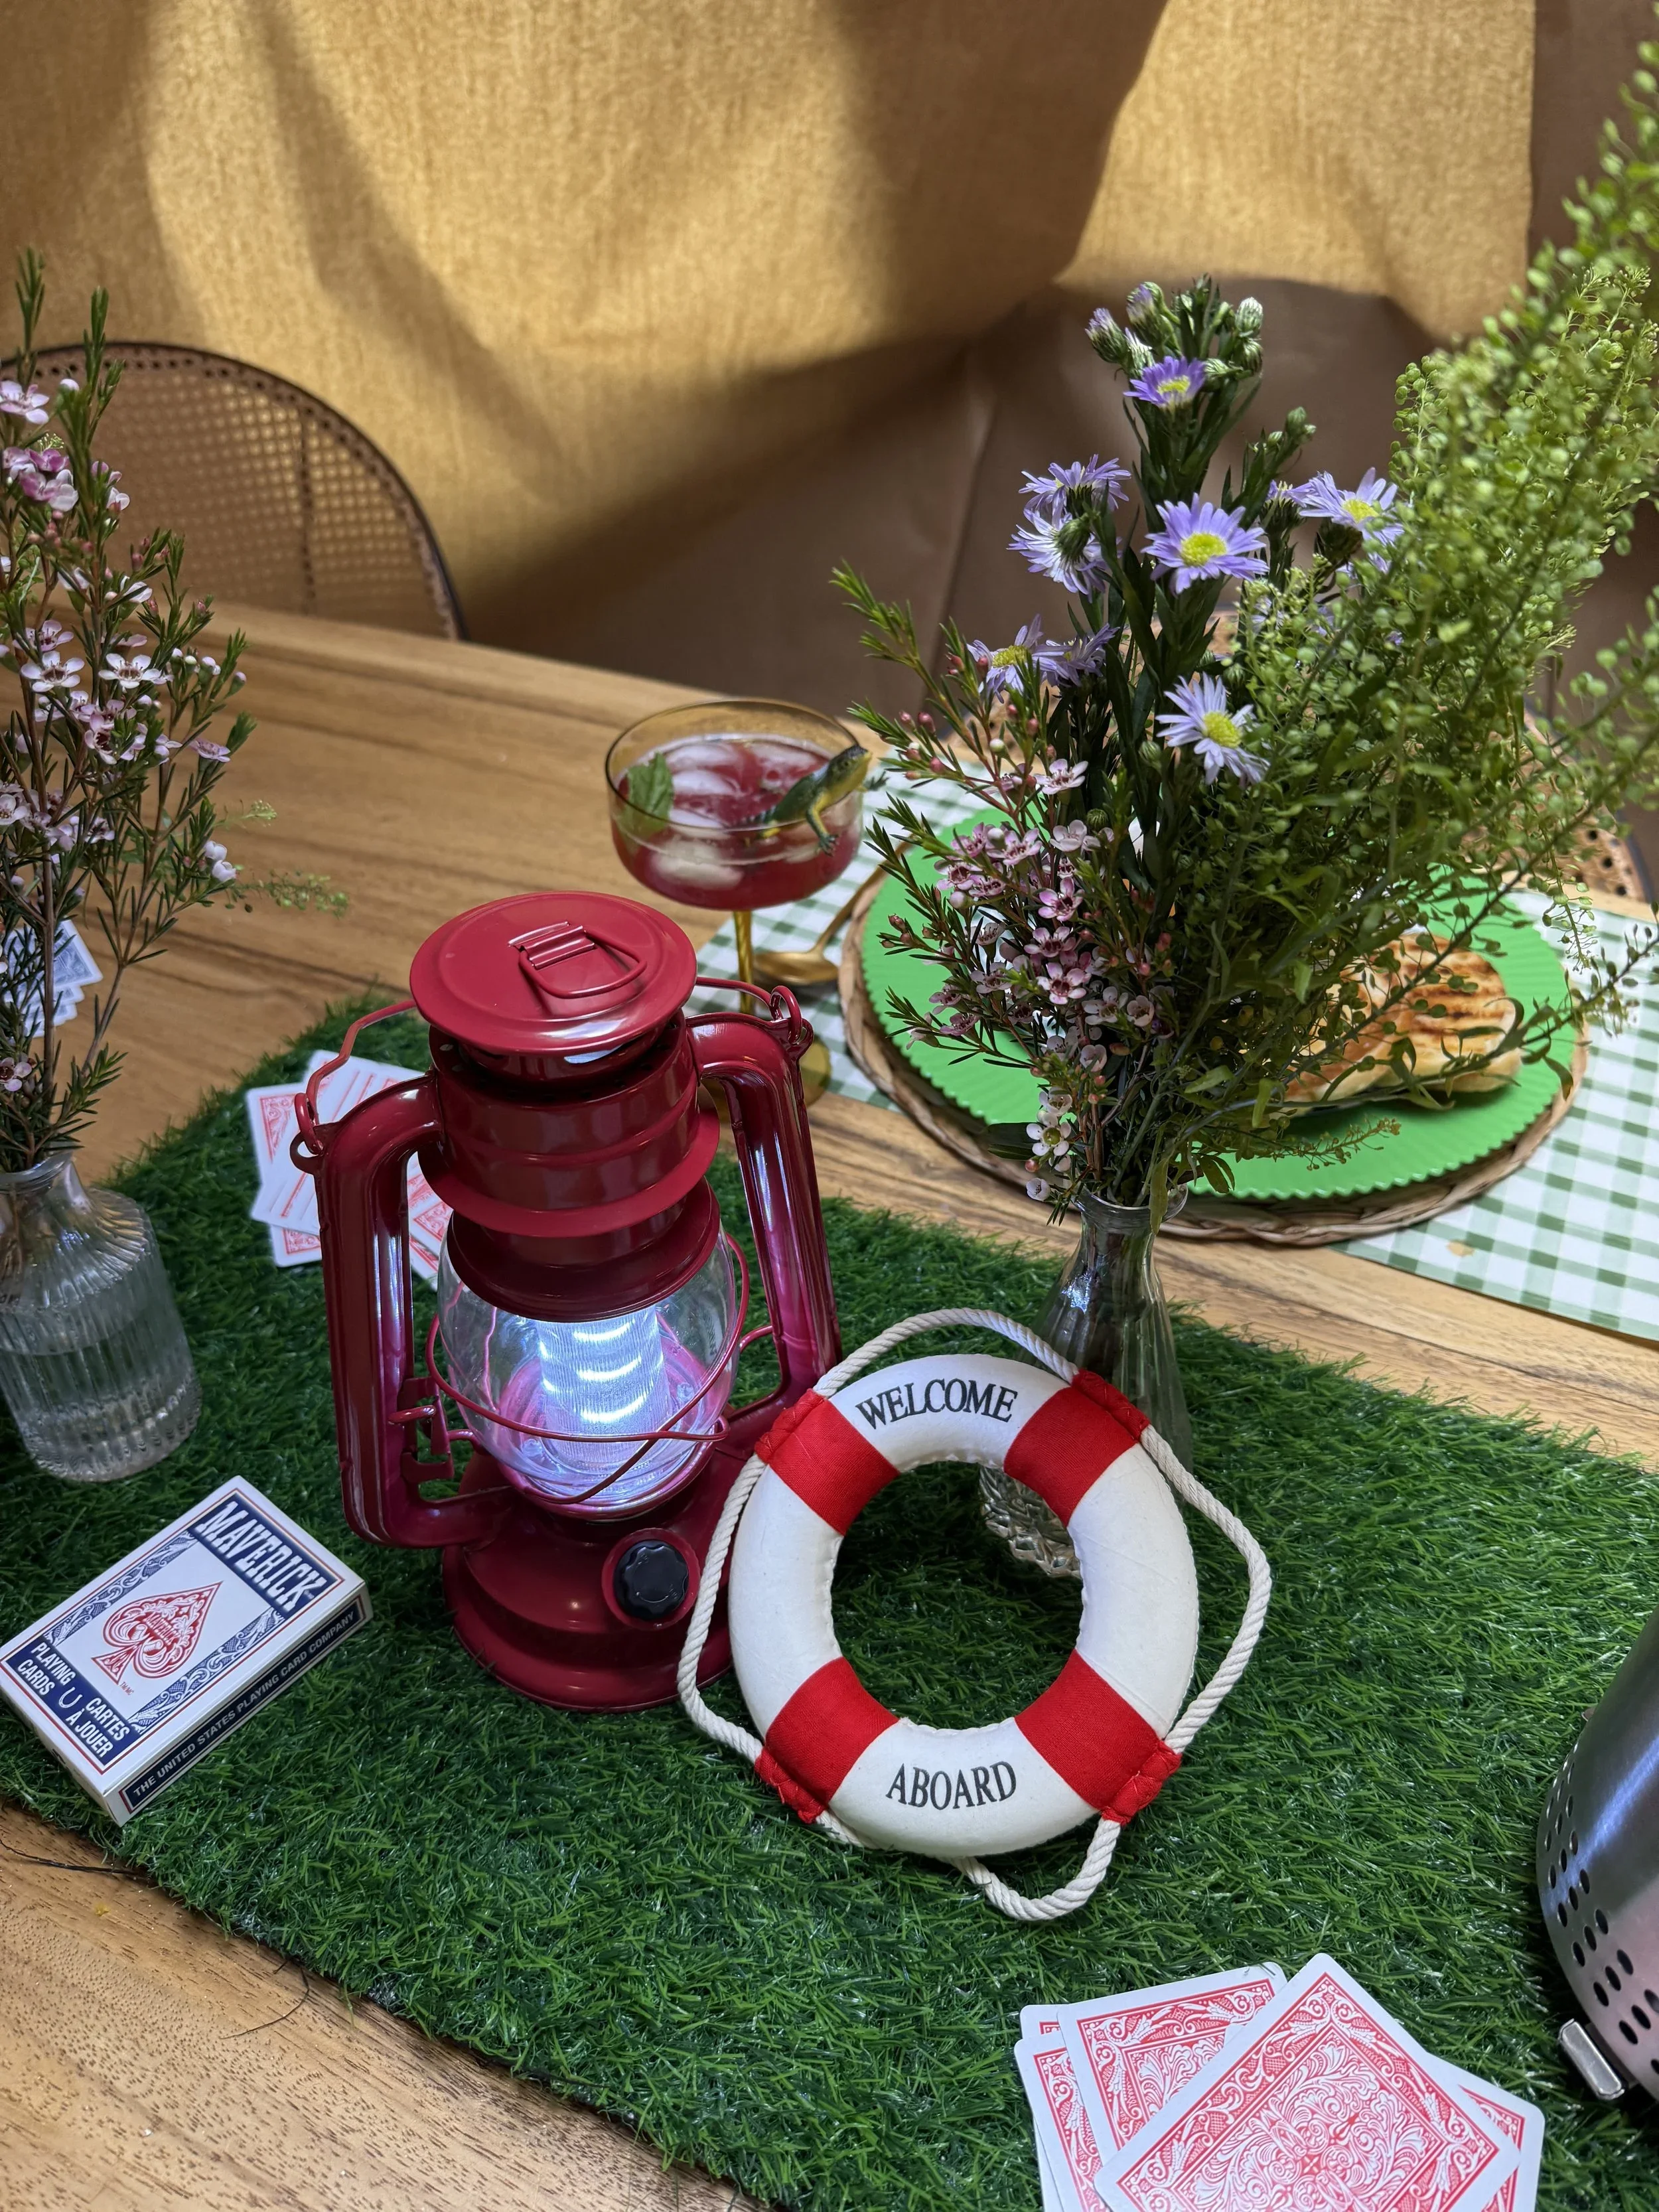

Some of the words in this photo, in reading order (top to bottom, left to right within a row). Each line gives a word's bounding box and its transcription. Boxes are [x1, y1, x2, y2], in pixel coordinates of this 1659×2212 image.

[855, 1378, 1018, 1430] WELCOME
[194, 1501, 327, 1612] MAVERICK
[143, 1611, 181, 1645] MAVERICK
[17, 1659, 55, 1696] CARDS
[31, 1642, 76, 1686] PLAYING
[85, 1698, 130, 1741] CARTES
[133, 1775, 157, 1797] THE
[157, 1743, 196, 1778] UNITED
[197, 1710, 236, 1745] STATES
[236, 1674, 279, 1712] PLAYING
[281, 1651, 307, 1676] CARD
[309, 1611, 354, 1653] COMPANY
[74, 1720, 113, 1757] JOUER
[885, 1761, 1017, 1810] ABOARD
